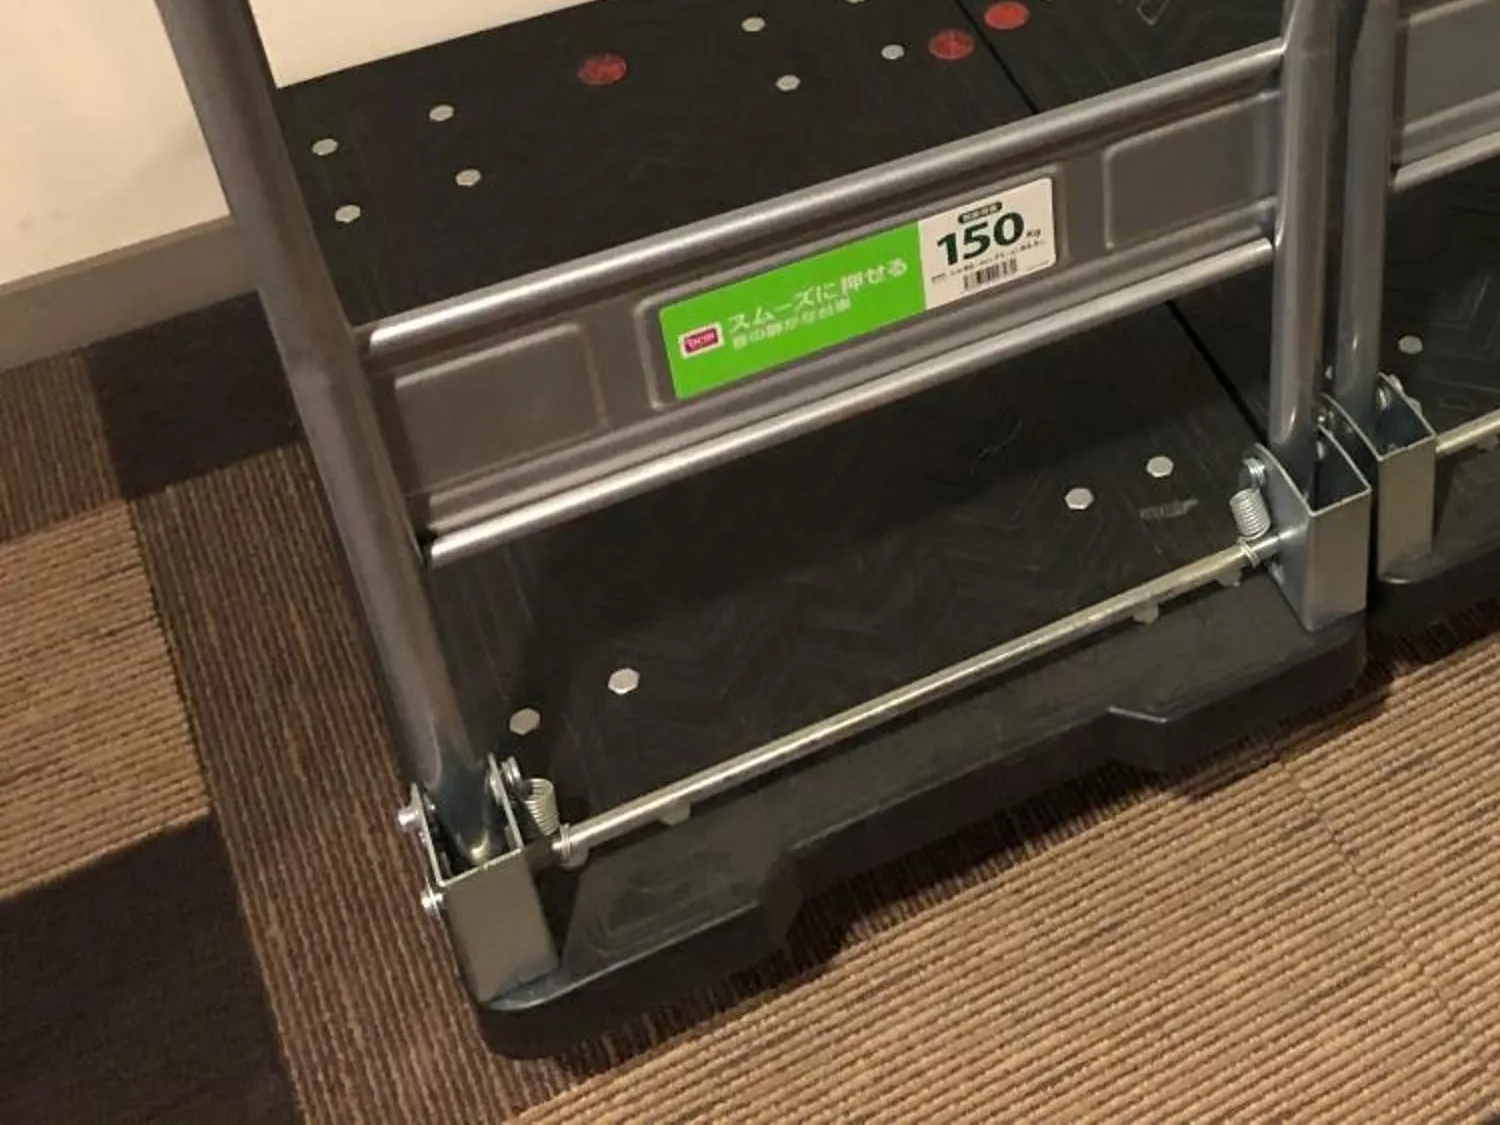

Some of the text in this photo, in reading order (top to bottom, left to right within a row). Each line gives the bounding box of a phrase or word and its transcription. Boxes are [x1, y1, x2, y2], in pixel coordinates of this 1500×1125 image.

[936, 211, 1024, 266] 150
[727, 257, 909, 333] スムーズに押せる
